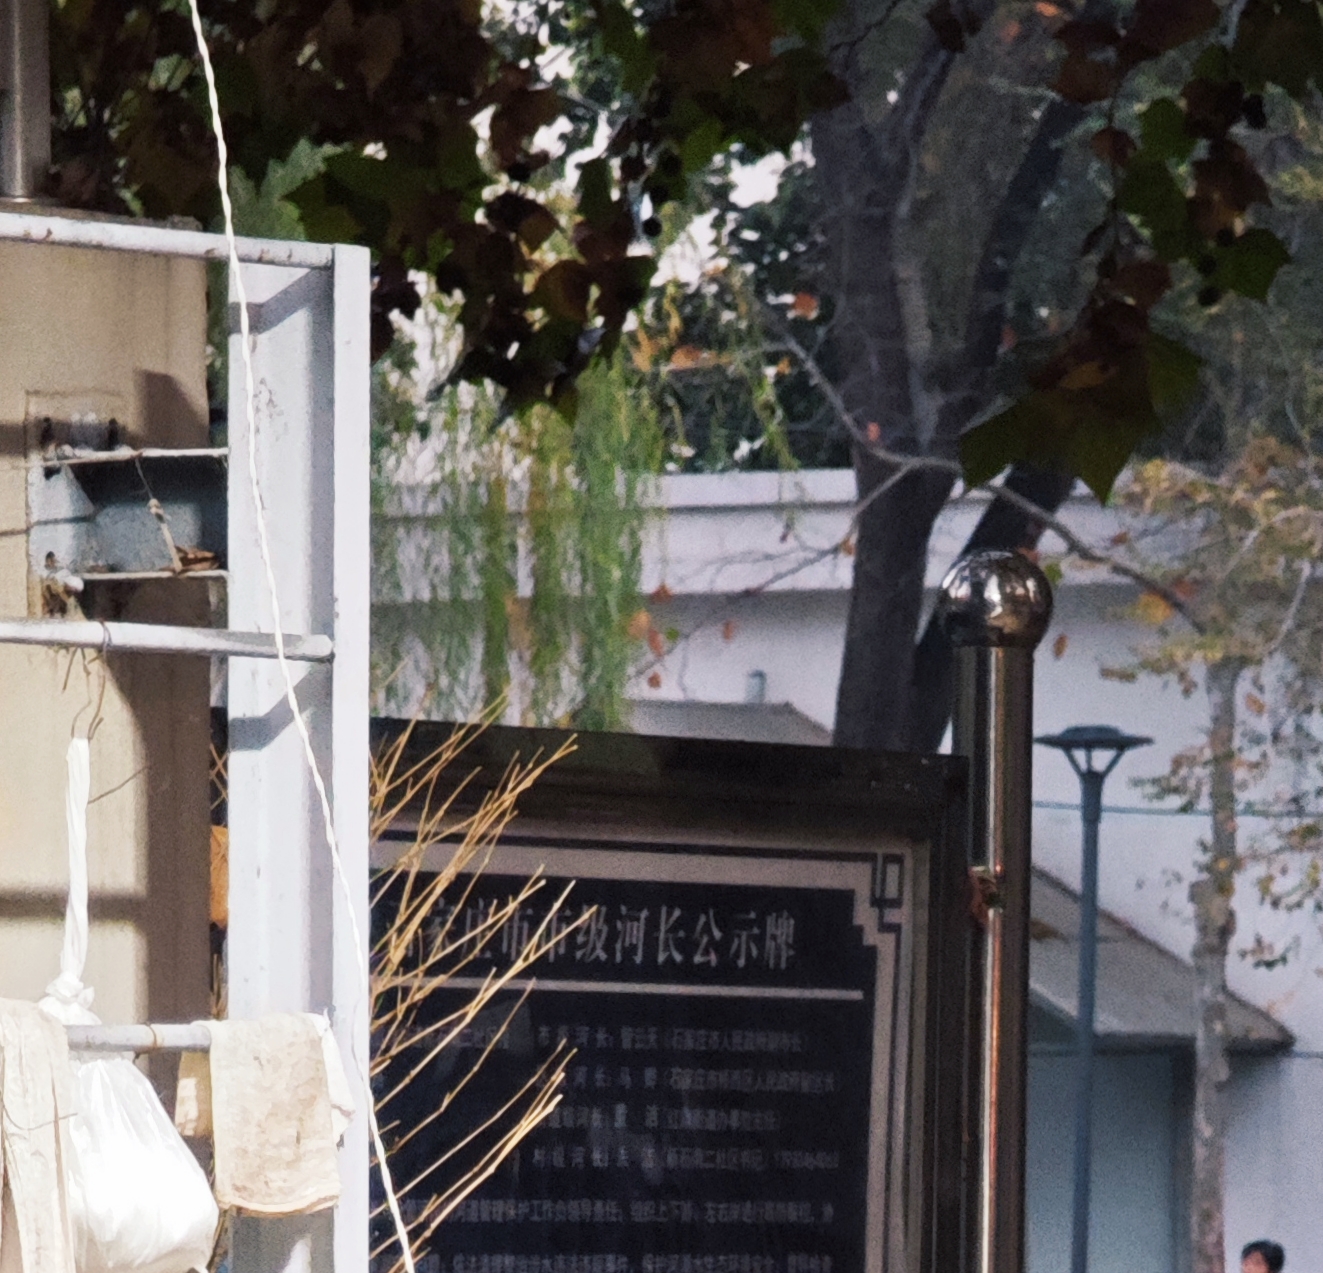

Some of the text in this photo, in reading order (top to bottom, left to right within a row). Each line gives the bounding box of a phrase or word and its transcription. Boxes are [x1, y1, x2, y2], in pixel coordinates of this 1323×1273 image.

[386, 897, 796, 970] 家庄市市级河长公示牌
